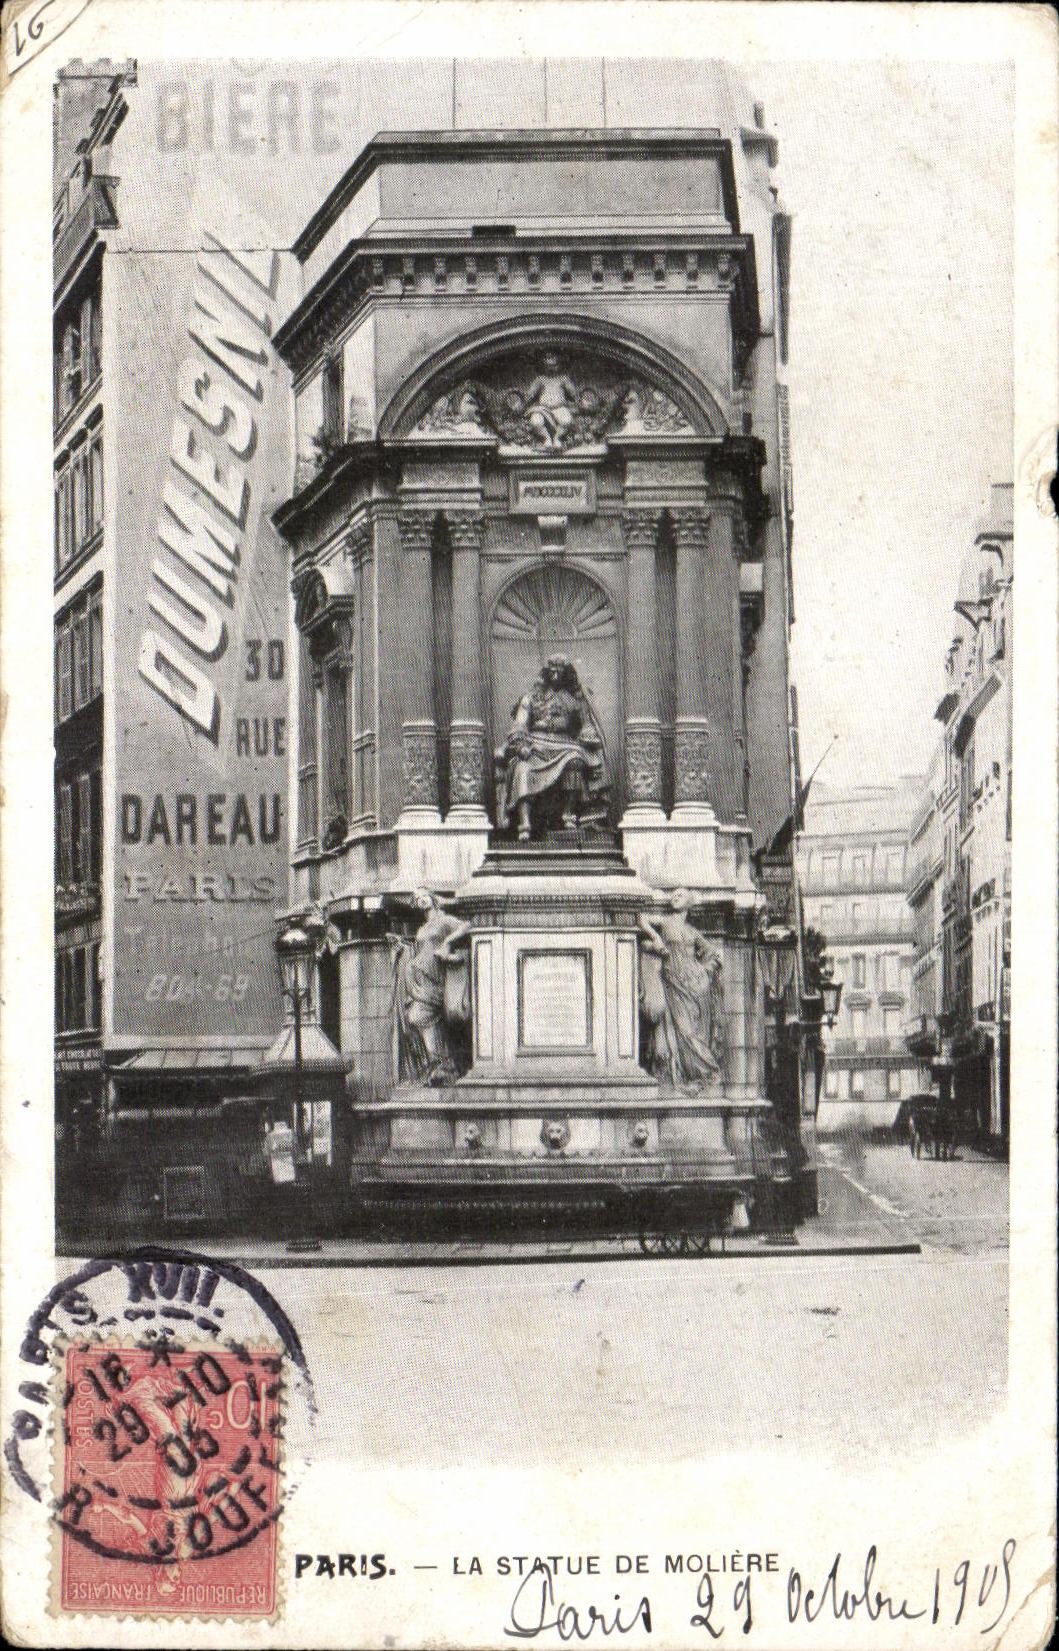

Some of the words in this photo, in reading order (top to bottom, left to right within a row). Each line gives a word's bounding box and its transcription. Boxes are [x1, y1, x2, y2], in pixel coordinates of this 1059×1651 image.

[138, 226, 282, 747] DUMESNIL
[246, 639, 284, 681] 30
[237, 717, 285, 756] RUE
[122, 793, 280, 845] DAREAU
[121, 872, 278, 904] PARIS
[503, 1562, 652, 1640] Paris
[690, 1573, 754, 1638] 29
